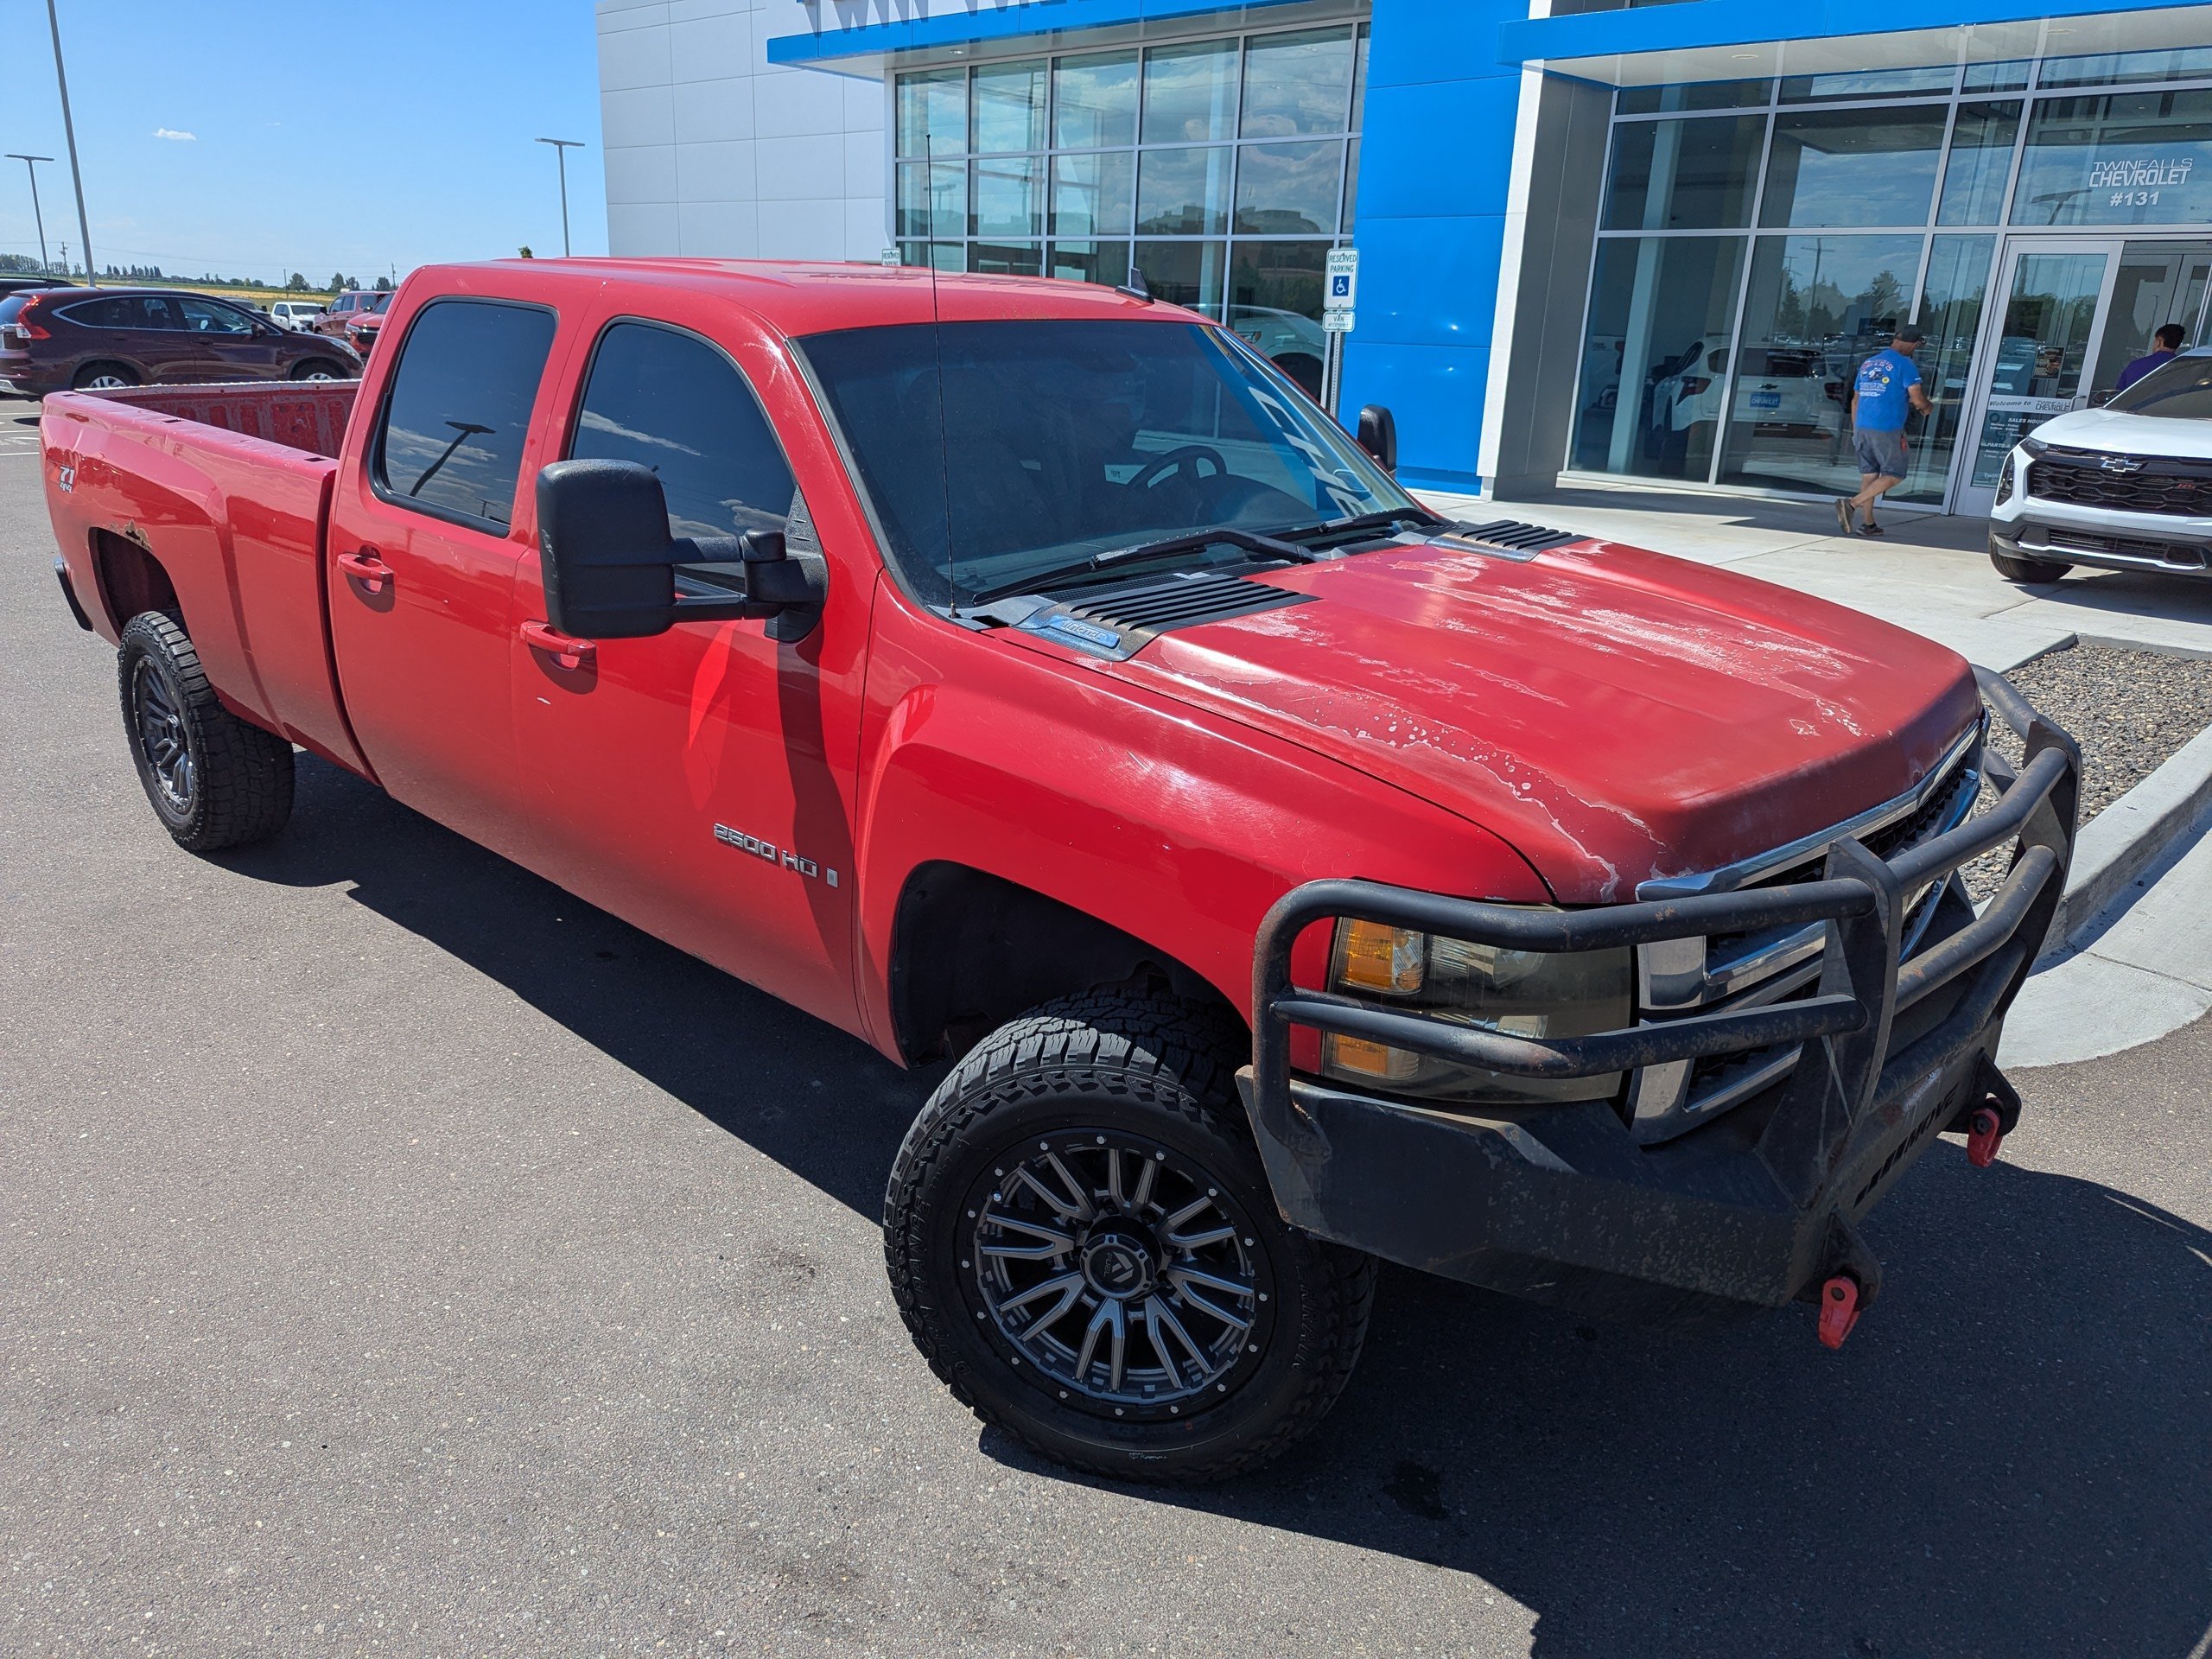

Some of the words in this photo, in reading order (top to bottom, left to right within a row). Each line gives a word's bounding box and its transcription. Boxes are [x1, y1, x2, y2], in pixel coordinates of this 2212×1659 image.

[2094, 158, 2193, 171] TWINFALLS
[2088, 168, 2192, 188] CHEVROLET
[2110, 191, 2160, 207] #131
[1329, 254, 1357, 263] RESERVED
[1331, 264, 1354, 273] PARKING
[713, 823, 776, 861] 2500
[781, 849, 818, 878] HD
[909, 1195, 932, 1294] RANGE
[1103, 1252, 1113, 1278] FUEL
